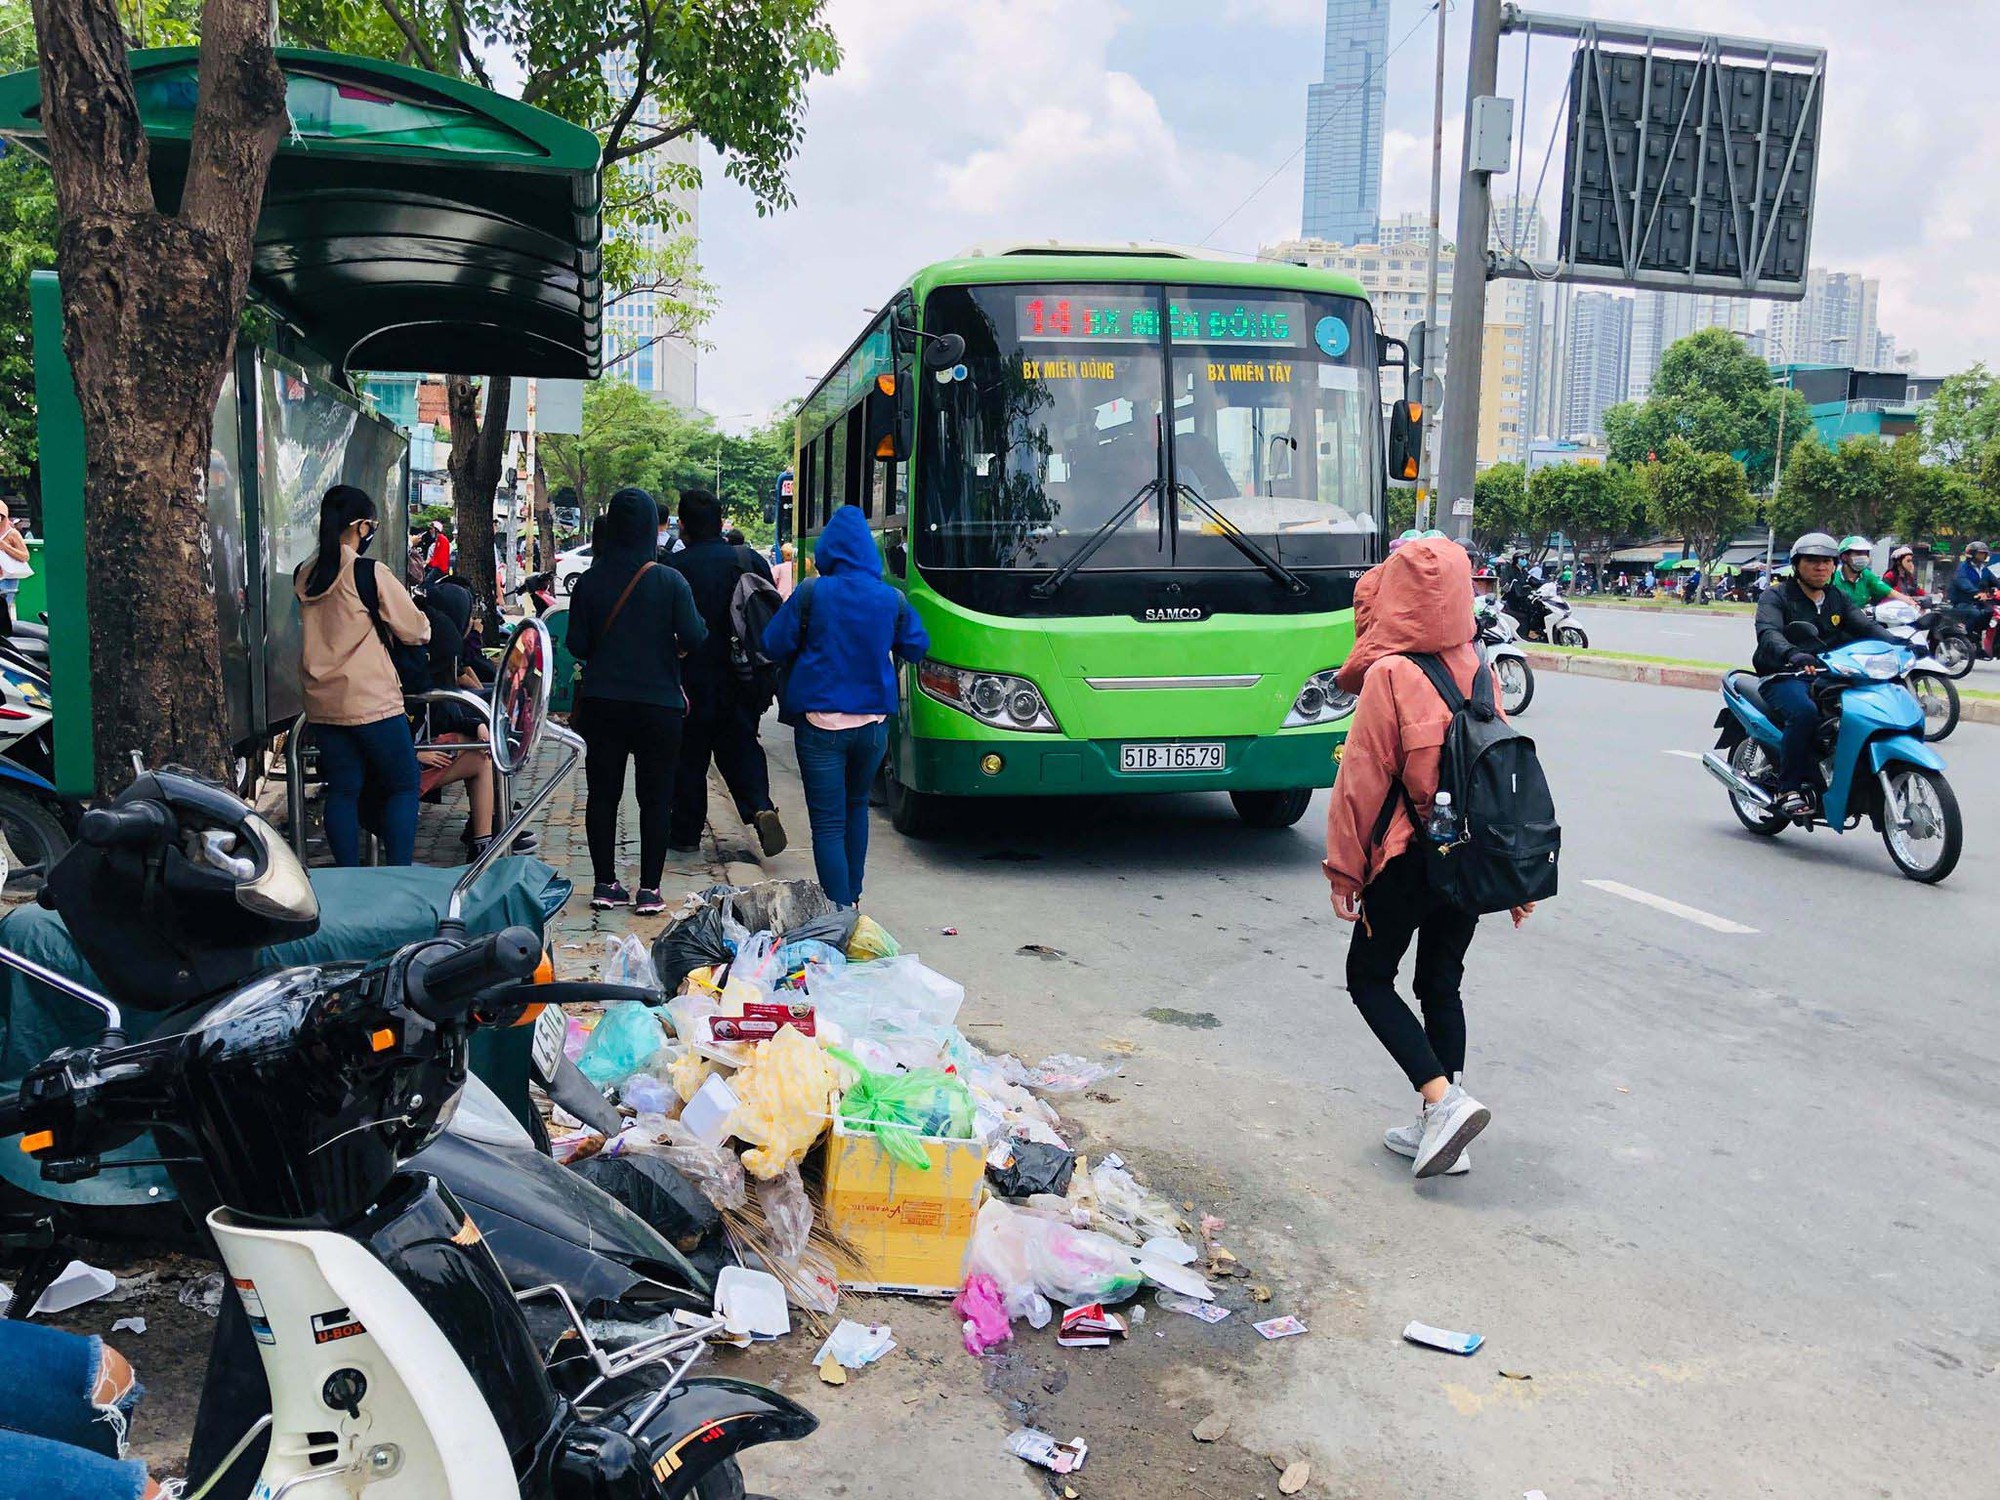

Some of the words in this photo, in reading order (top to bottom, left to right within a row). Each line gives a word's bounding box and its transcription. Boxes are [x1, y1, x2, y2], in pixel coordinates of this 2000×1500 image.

[1025, 299, 1071, 335] 14
[1083, 308, 1121, 335] BX
[1022, 361, 1040, 380] BX
[1207, 364, 1226, 382] BX
[1267, 362, 1292, 383] TÂY
[1145, 608, 1201, 620] SAMCO
[1124, 747, 1220, 768] 51B-165.79
[317, 1324, 363, 1343] U-BOX
